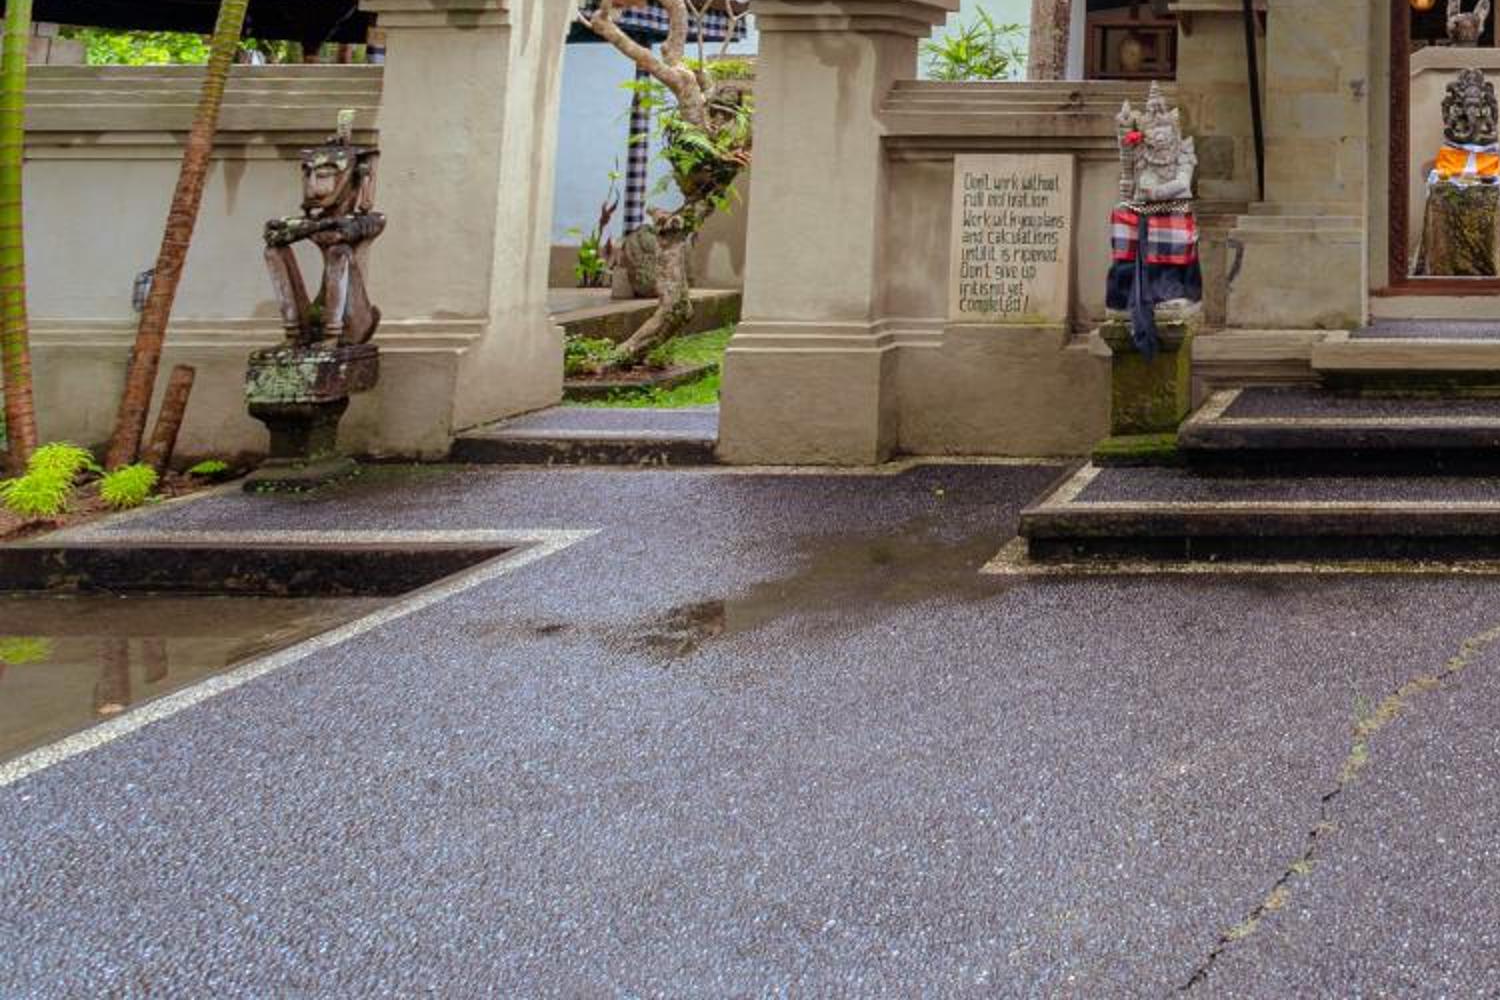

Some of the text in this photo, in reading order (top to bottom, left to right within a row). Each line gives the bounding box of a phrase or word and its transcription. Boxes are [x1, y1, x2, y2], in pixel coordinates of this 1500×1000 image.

[963, 210, 991, 228] Work
[987, 228, 1058, 244] calculations
[1001, 249, 1011, 262] is
[994, 265, 1018, 281] give
